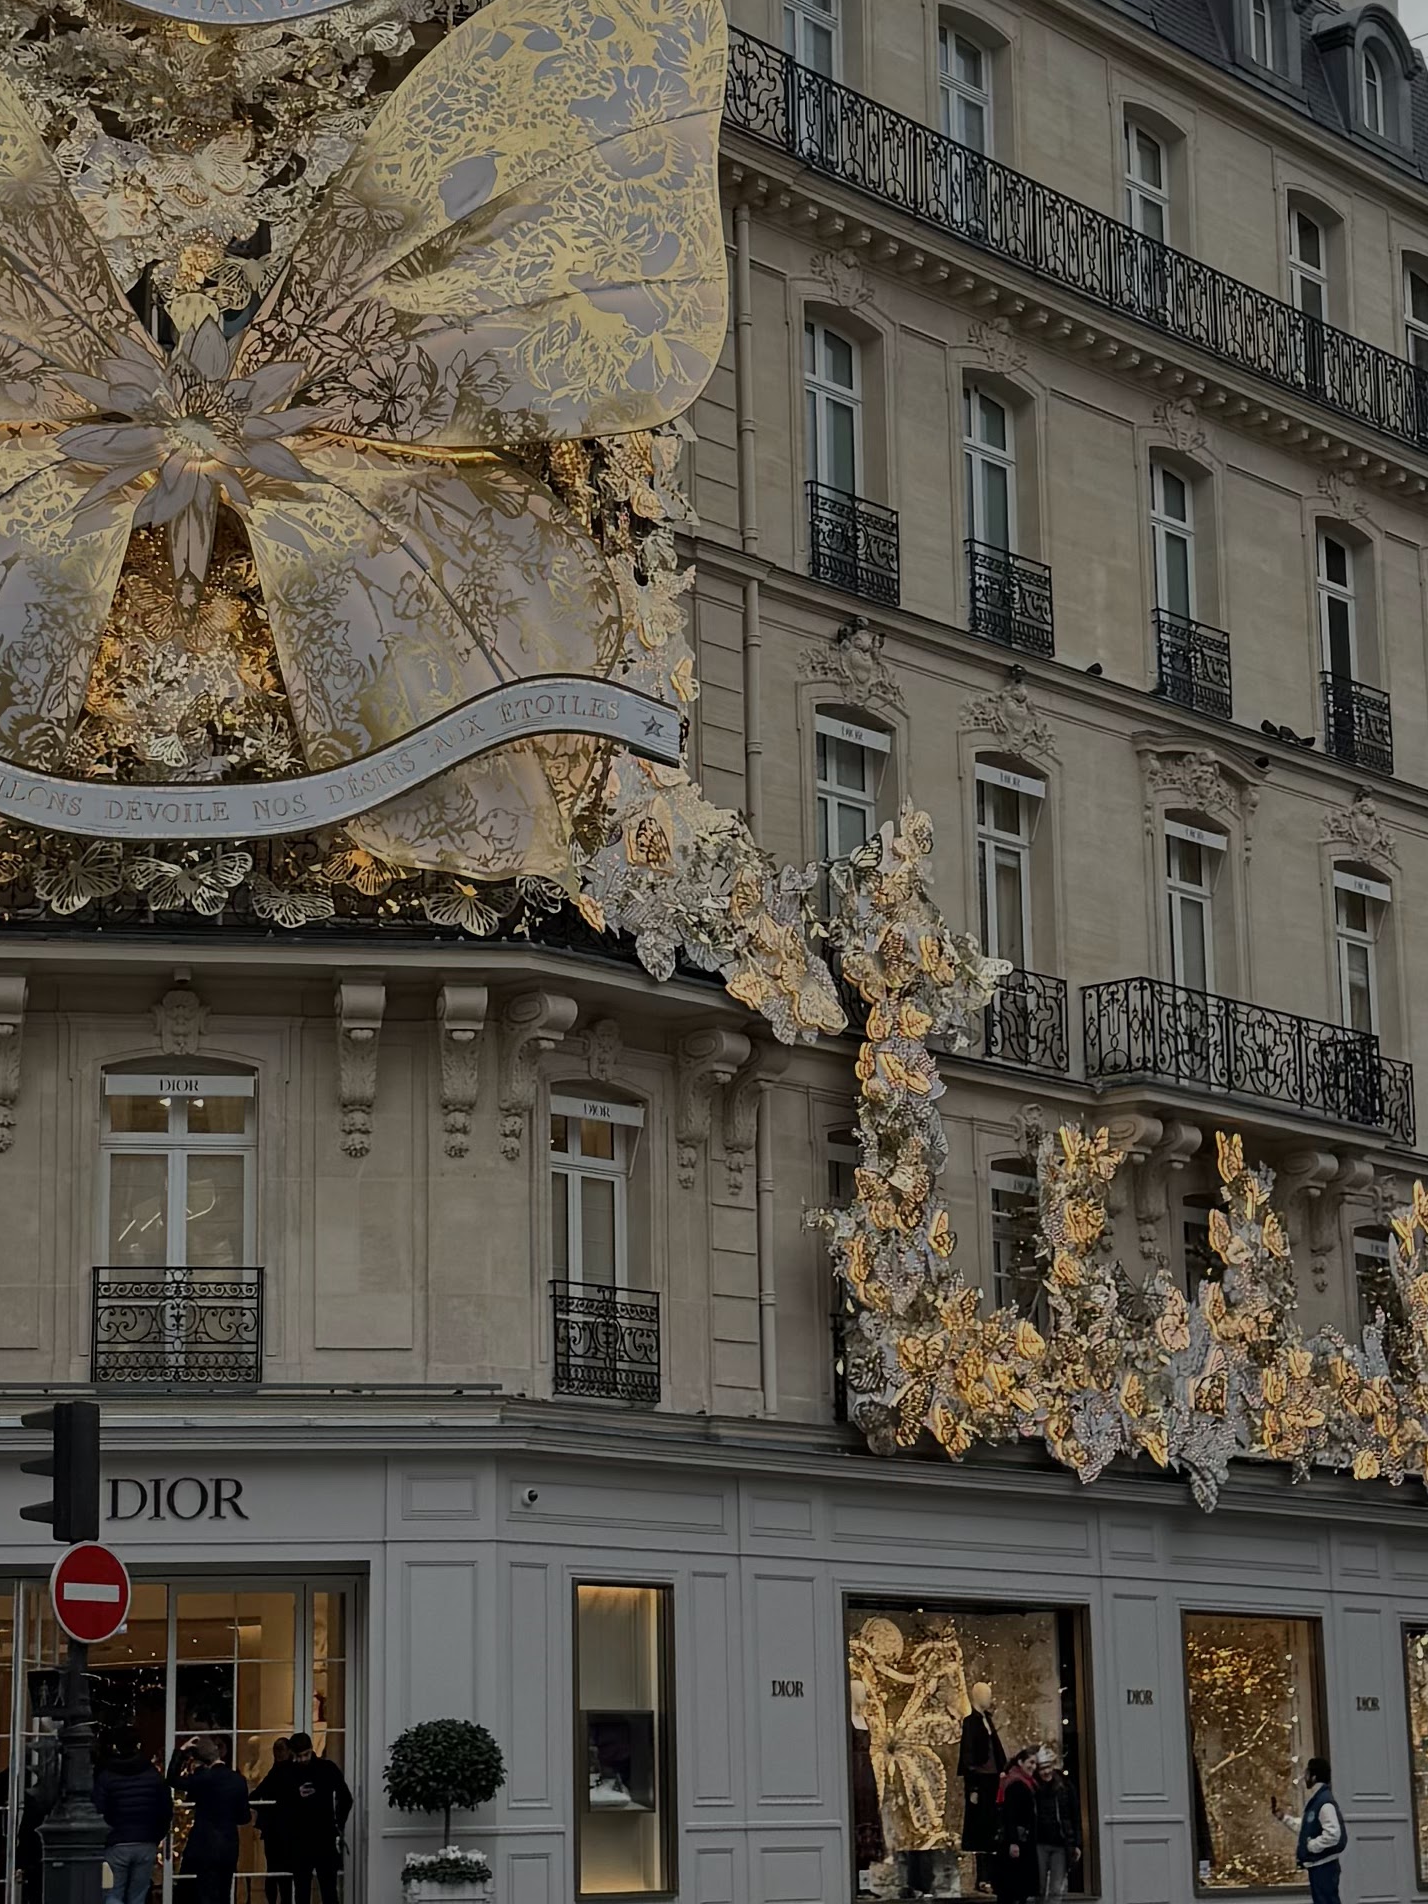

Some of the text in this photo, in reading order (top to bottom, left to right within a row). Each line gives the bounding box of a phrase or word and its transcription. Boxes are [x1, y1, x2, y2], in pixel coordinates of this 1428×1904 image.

[105, 795, 229, 823] DÉVOILE
[253, 793, 308, 821] NOS
[324, 752, 416, 806] DÉSIRS
[430, 714, 486, 756] AUX
[159, 1079, 199, 1092] DIOR
[583, 1102, 611, 1118] DIOR
[106, 1477, 250, 1521] DIOR
[771, 1680, 804, 1698] DIOR
[1127, 1689, 1154, 1705] DIOR
